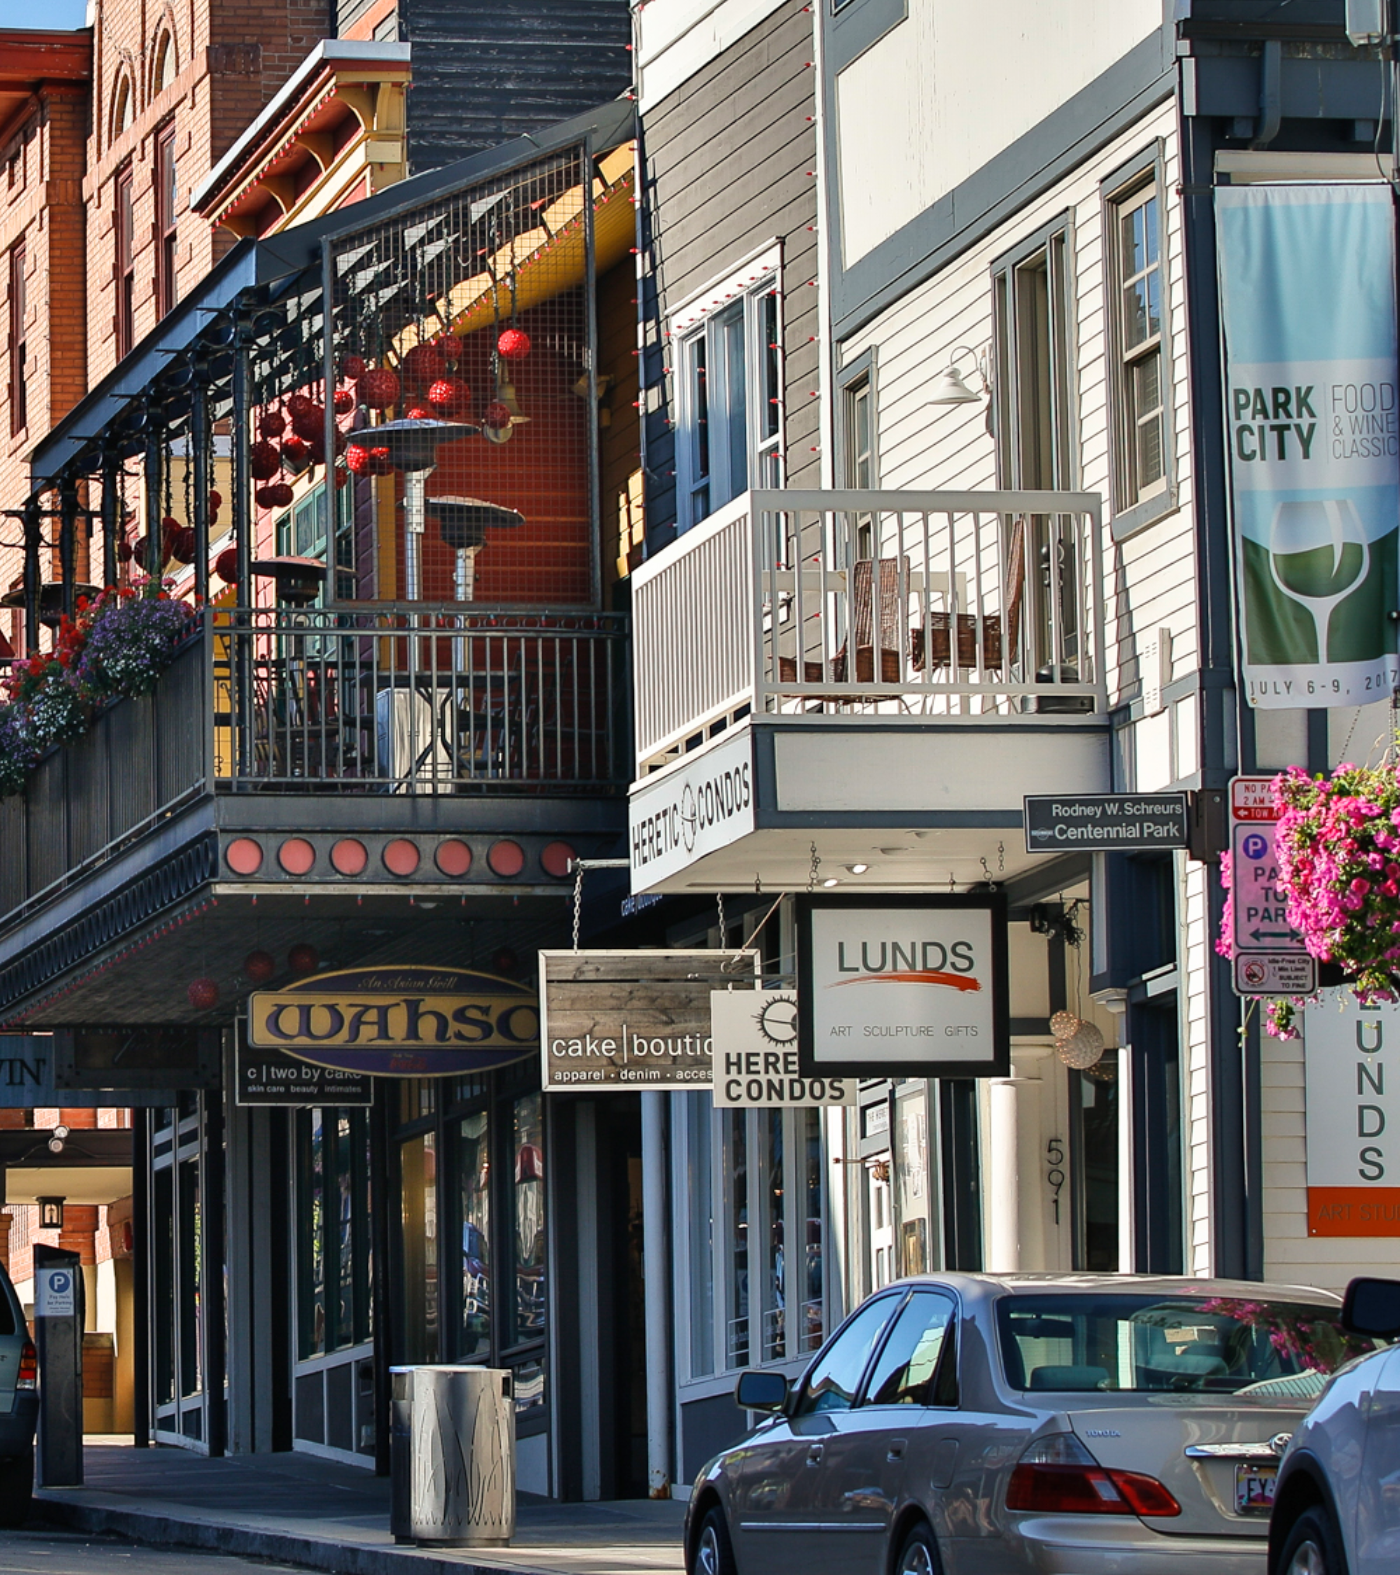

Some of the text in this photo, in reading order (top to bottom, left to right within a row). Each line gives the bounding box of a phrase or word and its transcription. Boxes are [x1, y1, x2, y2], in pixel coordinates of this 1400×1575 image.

[1233, 385, 1317, 420] PARK
[1332, 382, 1395, 413] FOOD
[1332, 412, 1397, 437] & WINE
[1235, 422, 1317, 462] CITY
[1332, 436, 1398, 460] CLASSIC
[1250, 680, 1293, 697] JULY
[1364, 669, 1399, 691] 2017
[1243, 783, 1257, 794] NO
[1052, 802, 1183, 818] Rodney W. Schreurs
[1252, 796, 1265, 806] AM
[632, 761, 750, 870] HERETIC CONDOS
[1251, 808, 1269, 818] TOW
[1054, 821, 1180, 840] Centennial Park
[1253, 867, 1279, 882] PA
[1261, 886, 1288, 903] TO
[1246, 906, 1287, 923] PAR
[838, 940, 975, 973] LUNDS
[829, 1025, 978, 1037] ART SCULPTURE GIFTS
[552, 1033, 617, 1057] cake
[270, 1066, 298, 1079] two
[301, 1064, 321, 1082] by
[724, 1052, 798, 1075] HERE
[554, 1068, 714, 1082] apparel denim acces
[247, 1084, 362, 1094] skin care beauty intimates
[724, 1078, 845, 1102] CONDOS
[1356, 1003, 1386, 1181] UNDS
[1317, 1203, 1400, 1221] ART STU
